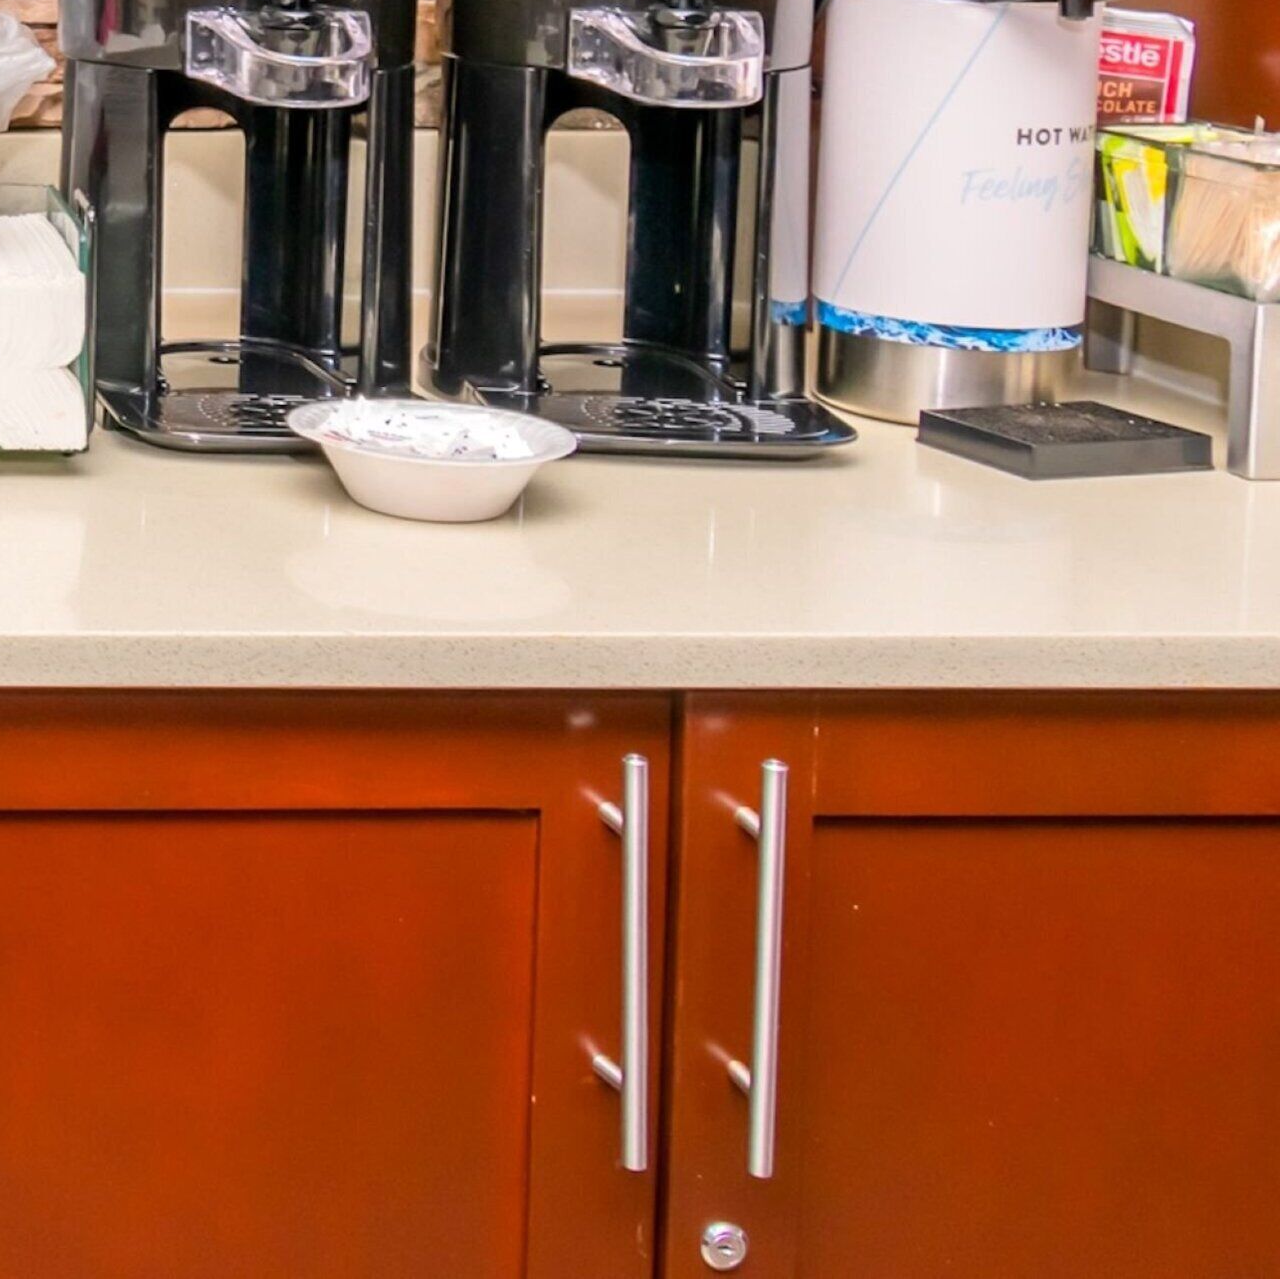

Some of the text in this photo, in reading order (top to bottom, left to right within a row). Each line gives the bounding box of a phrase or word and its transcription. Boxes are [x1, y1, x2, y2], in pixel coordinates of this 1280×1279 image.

[1100, 40, 1160, 68] stlé
[1017, 128, 1062, 145] HOT
[960, 166, 1058, 211] Feeling
